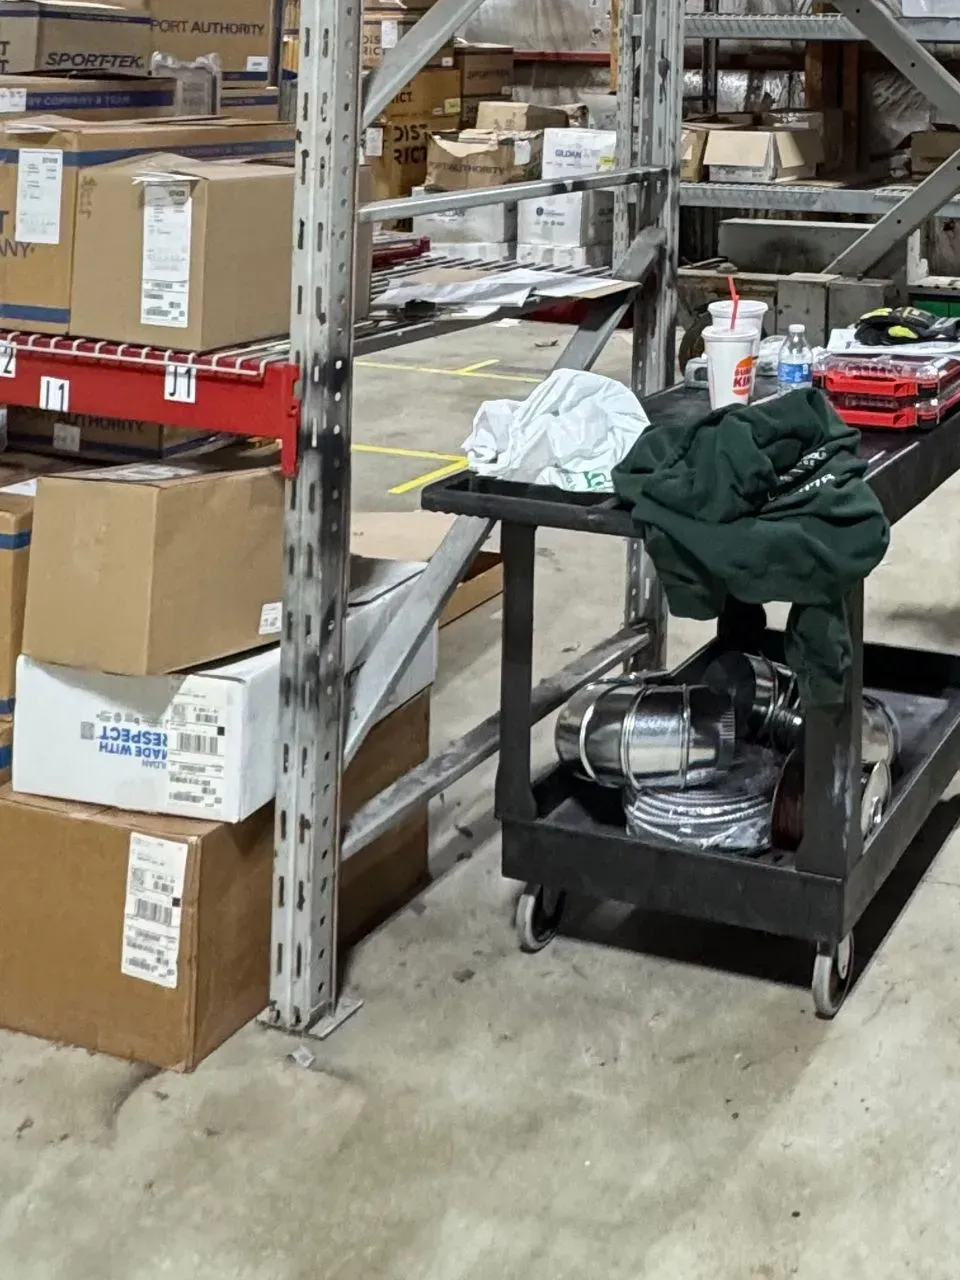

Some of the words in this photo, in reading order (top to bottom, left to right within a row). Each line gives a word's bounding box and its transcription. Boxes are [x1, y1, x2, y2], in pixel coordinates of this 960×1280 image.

[151, 19, 188, 34] PORT
[190, 18, 264, 37] AUTHORITY
[45, 51, 144, 69] SPORT-TEK
[168, 365, 192, 398] J1
[98, 740, 132, 757] WITH
